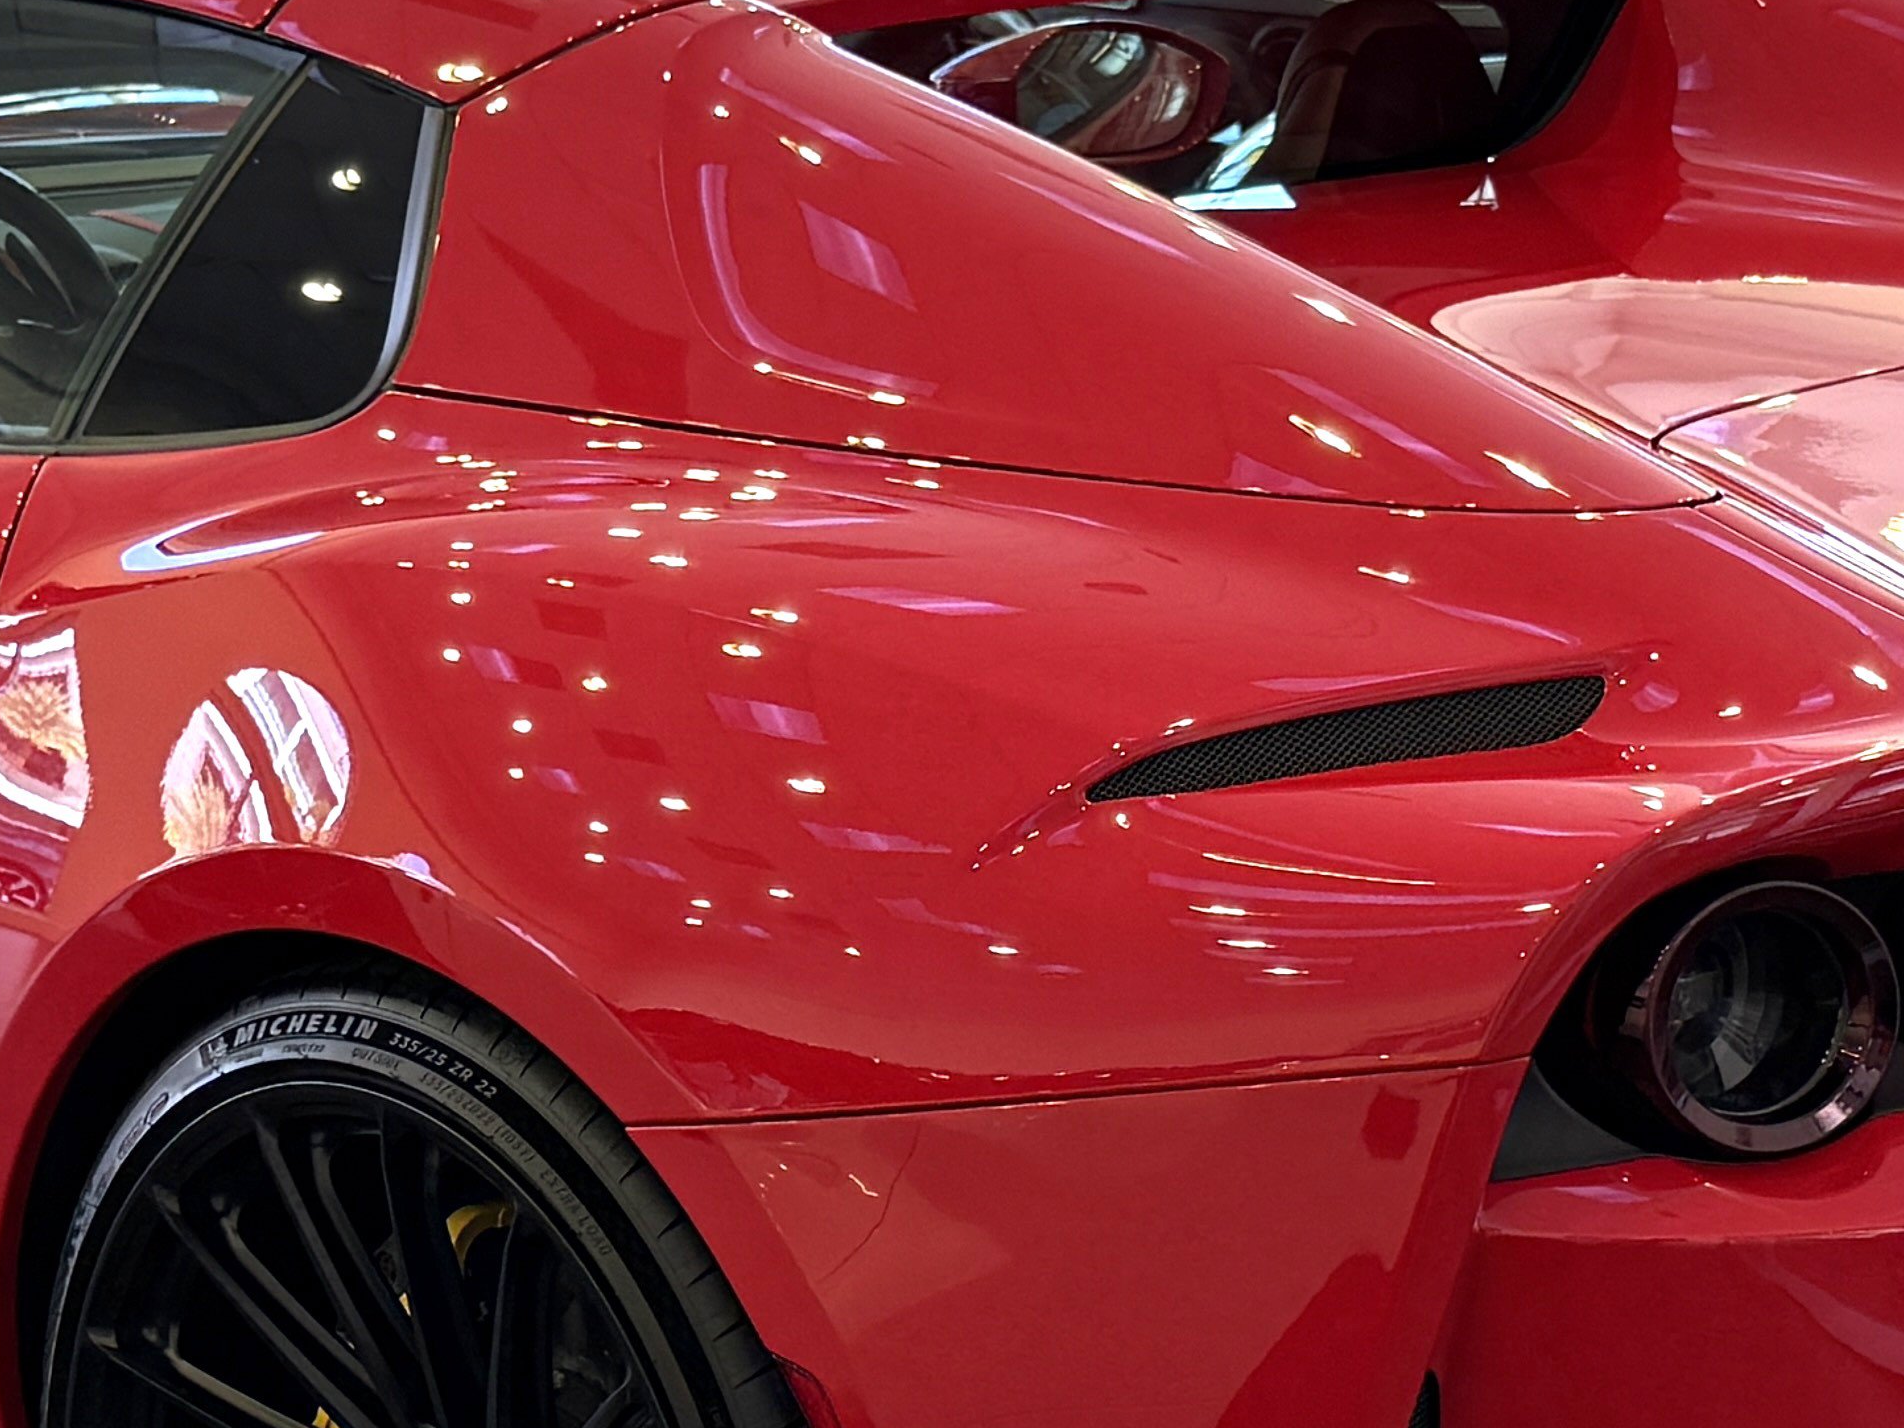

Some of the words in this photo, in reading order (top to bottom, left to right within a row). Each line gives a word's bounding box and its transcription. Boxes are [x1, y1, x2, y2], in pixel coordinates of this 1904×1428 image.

[232, 1011, 379, 1048] MICHELIN
[388, 1031, 446, 1069] 335/25
[448, 1060, 474, 1084] ZR
[476, 1077, 499, 1101] 22
